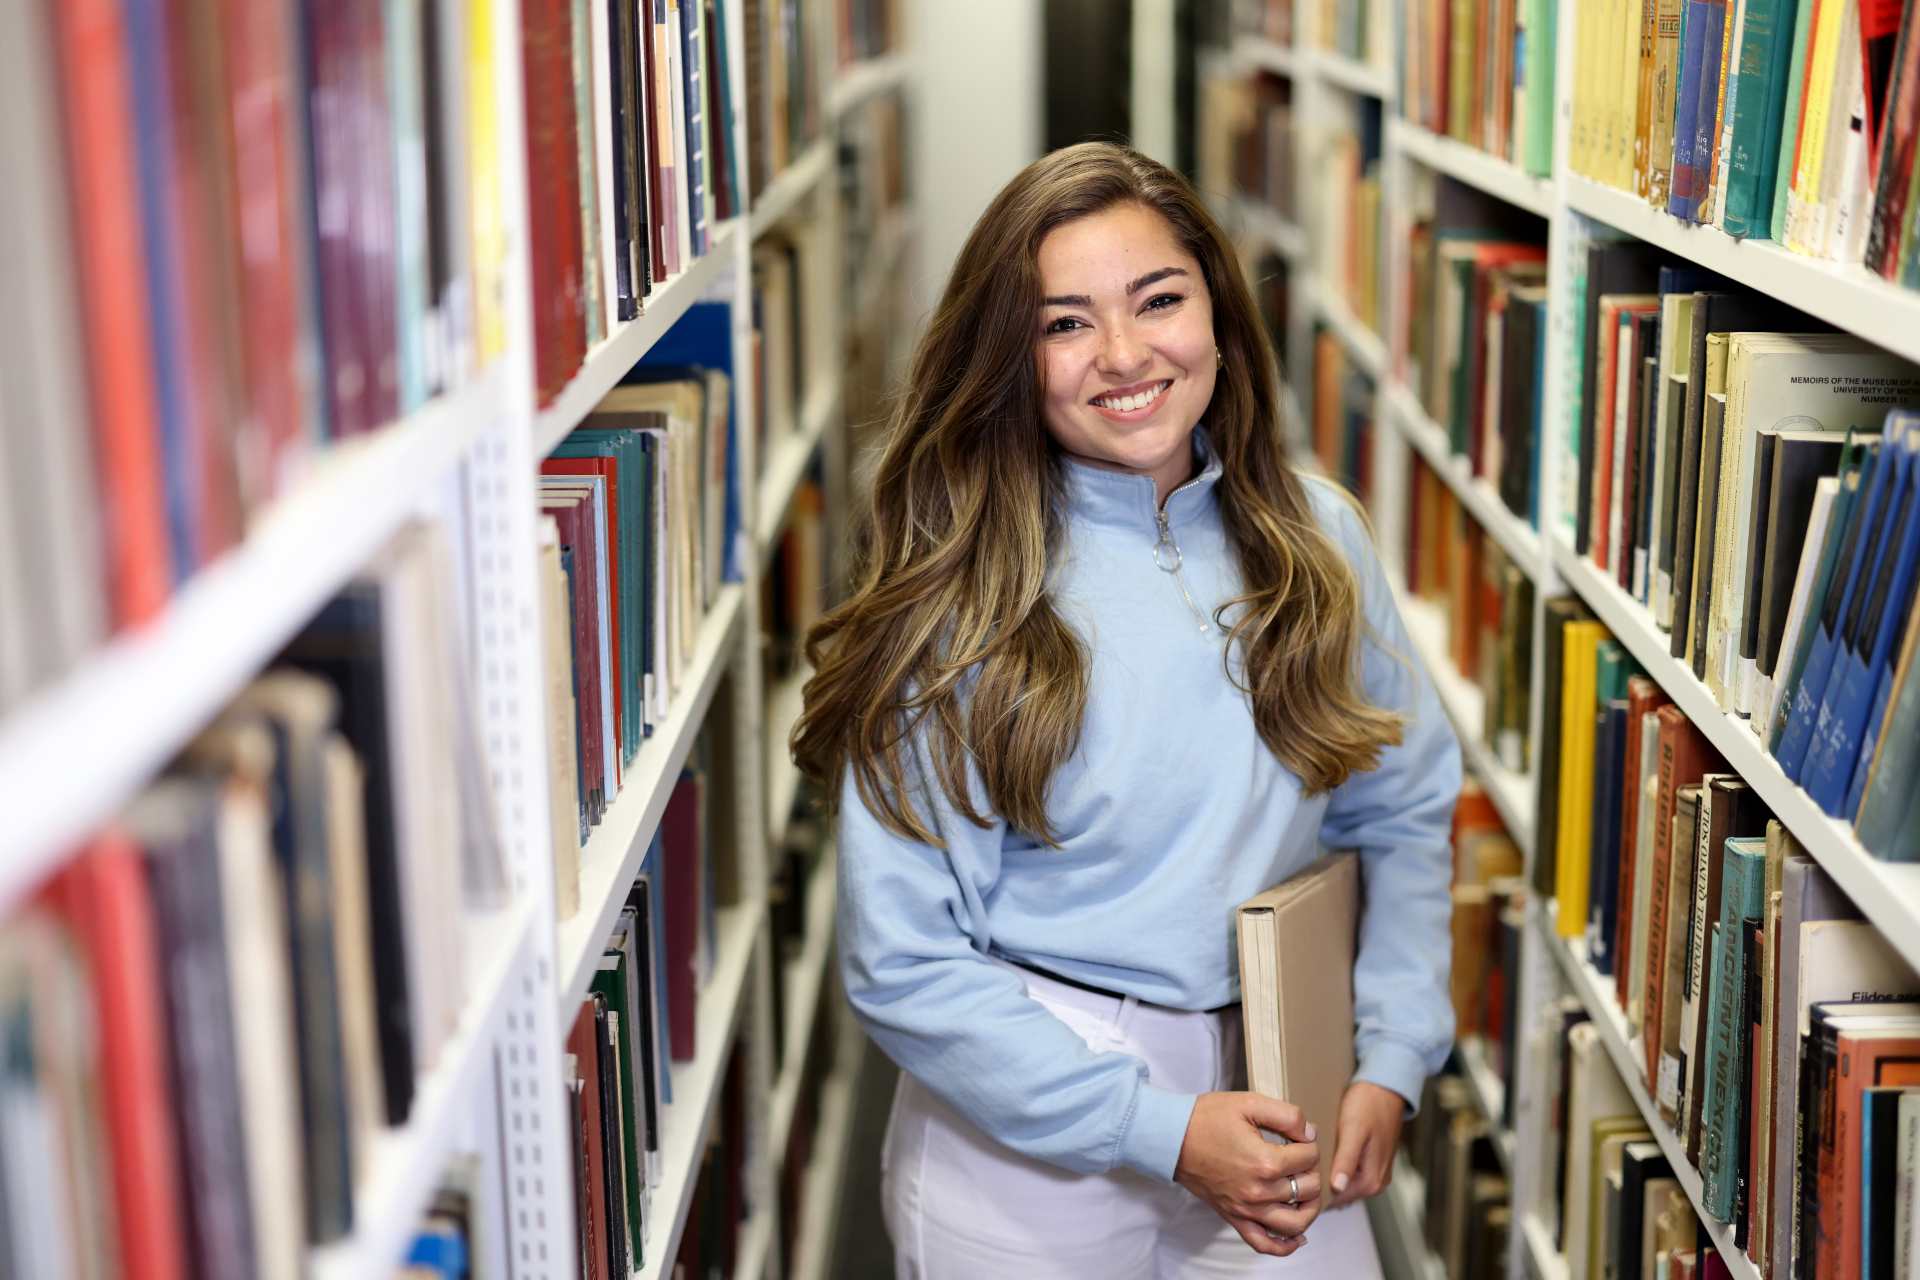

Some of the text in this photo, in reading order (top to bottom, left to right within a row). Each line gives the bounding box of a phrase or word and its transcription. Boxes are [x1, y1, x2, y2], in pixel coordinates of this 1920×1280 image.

[1790, 376, 1830, 385] MEMOIRS
[1831, 377, 1841, 385] OF
[1843, 377, 1860, 386] THE
[1861, 377, 1898, 386] MUSEUM
[1833, 386, 1882, 395] UNIVERSITY
[1883, 387, 1895, 395] OF
[1860, 395, 1897, 404] NUMBER
[1702, 807, 1711, 844] SOLE
[1697, 845, 1708, 901] QUINTO
[1718, 903, 1738, 1049] ANCIENT
[1707, 1051, 1729, 1174] MEXICO
